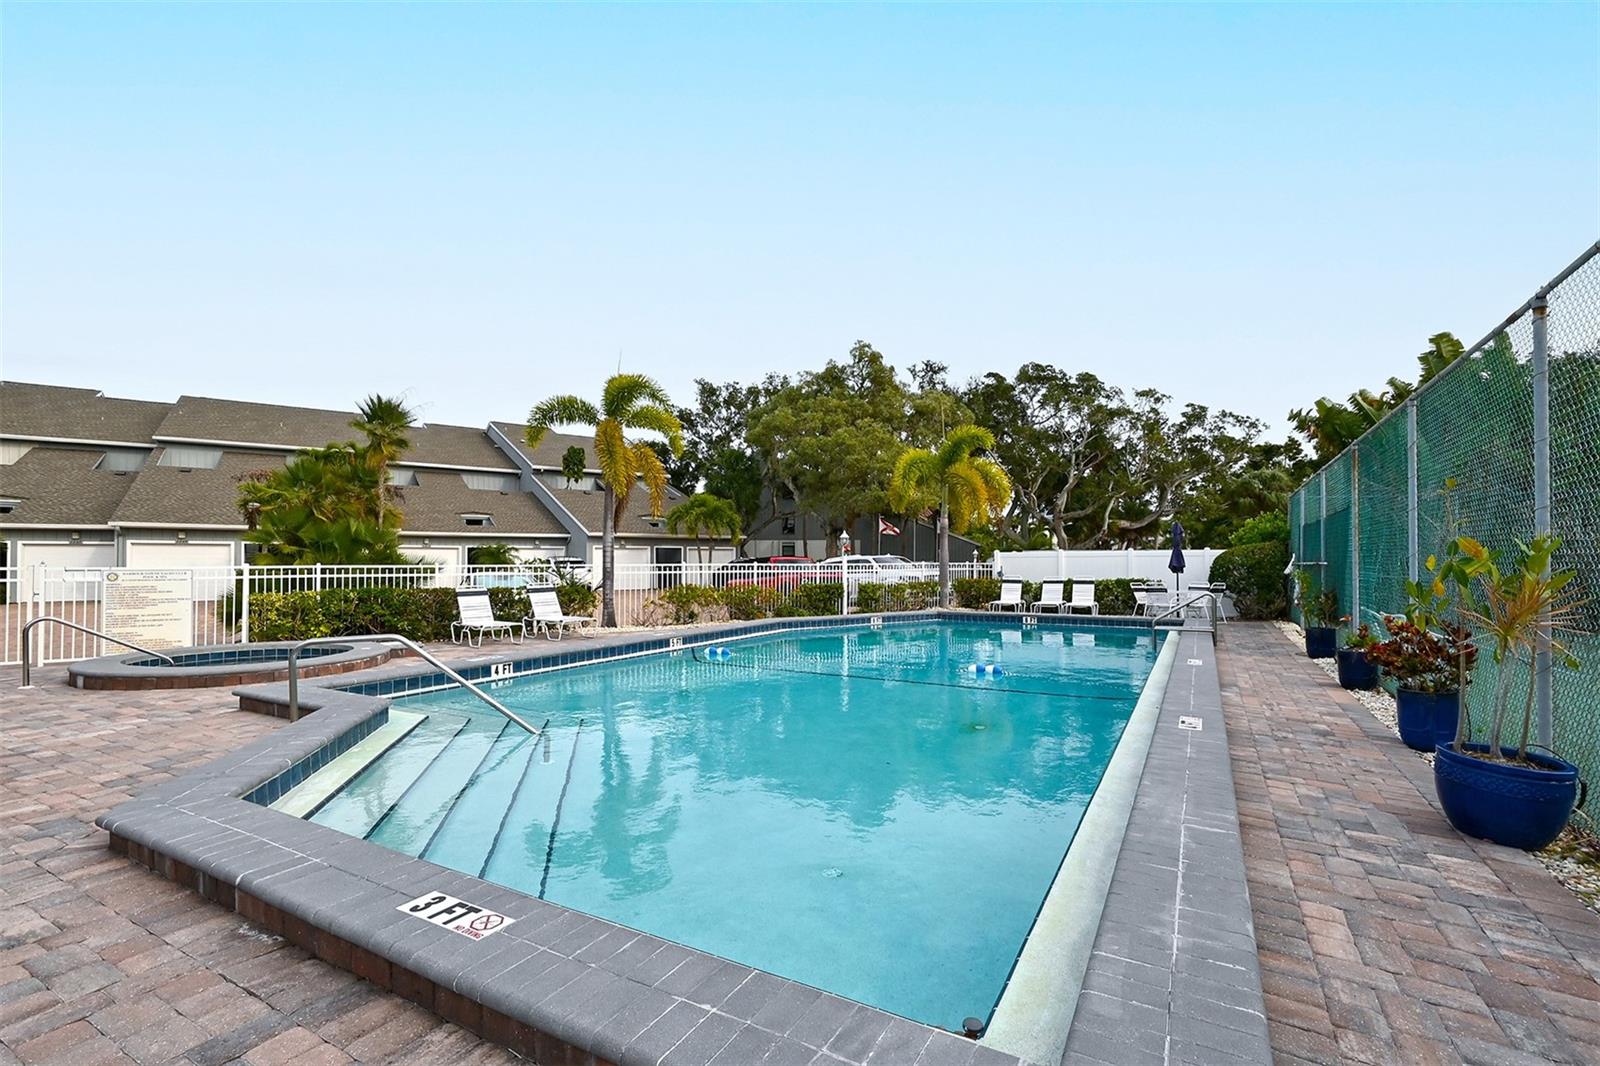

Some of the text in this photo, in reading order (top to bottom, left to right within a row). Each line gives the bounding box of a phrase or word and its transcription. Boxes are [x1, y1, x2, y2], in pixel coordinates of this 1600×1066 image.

[494, 663, 512, 677] 4 FT
[409, 896, 483, 926] 3 FT
[461, 928, 481, 939] DIVING
